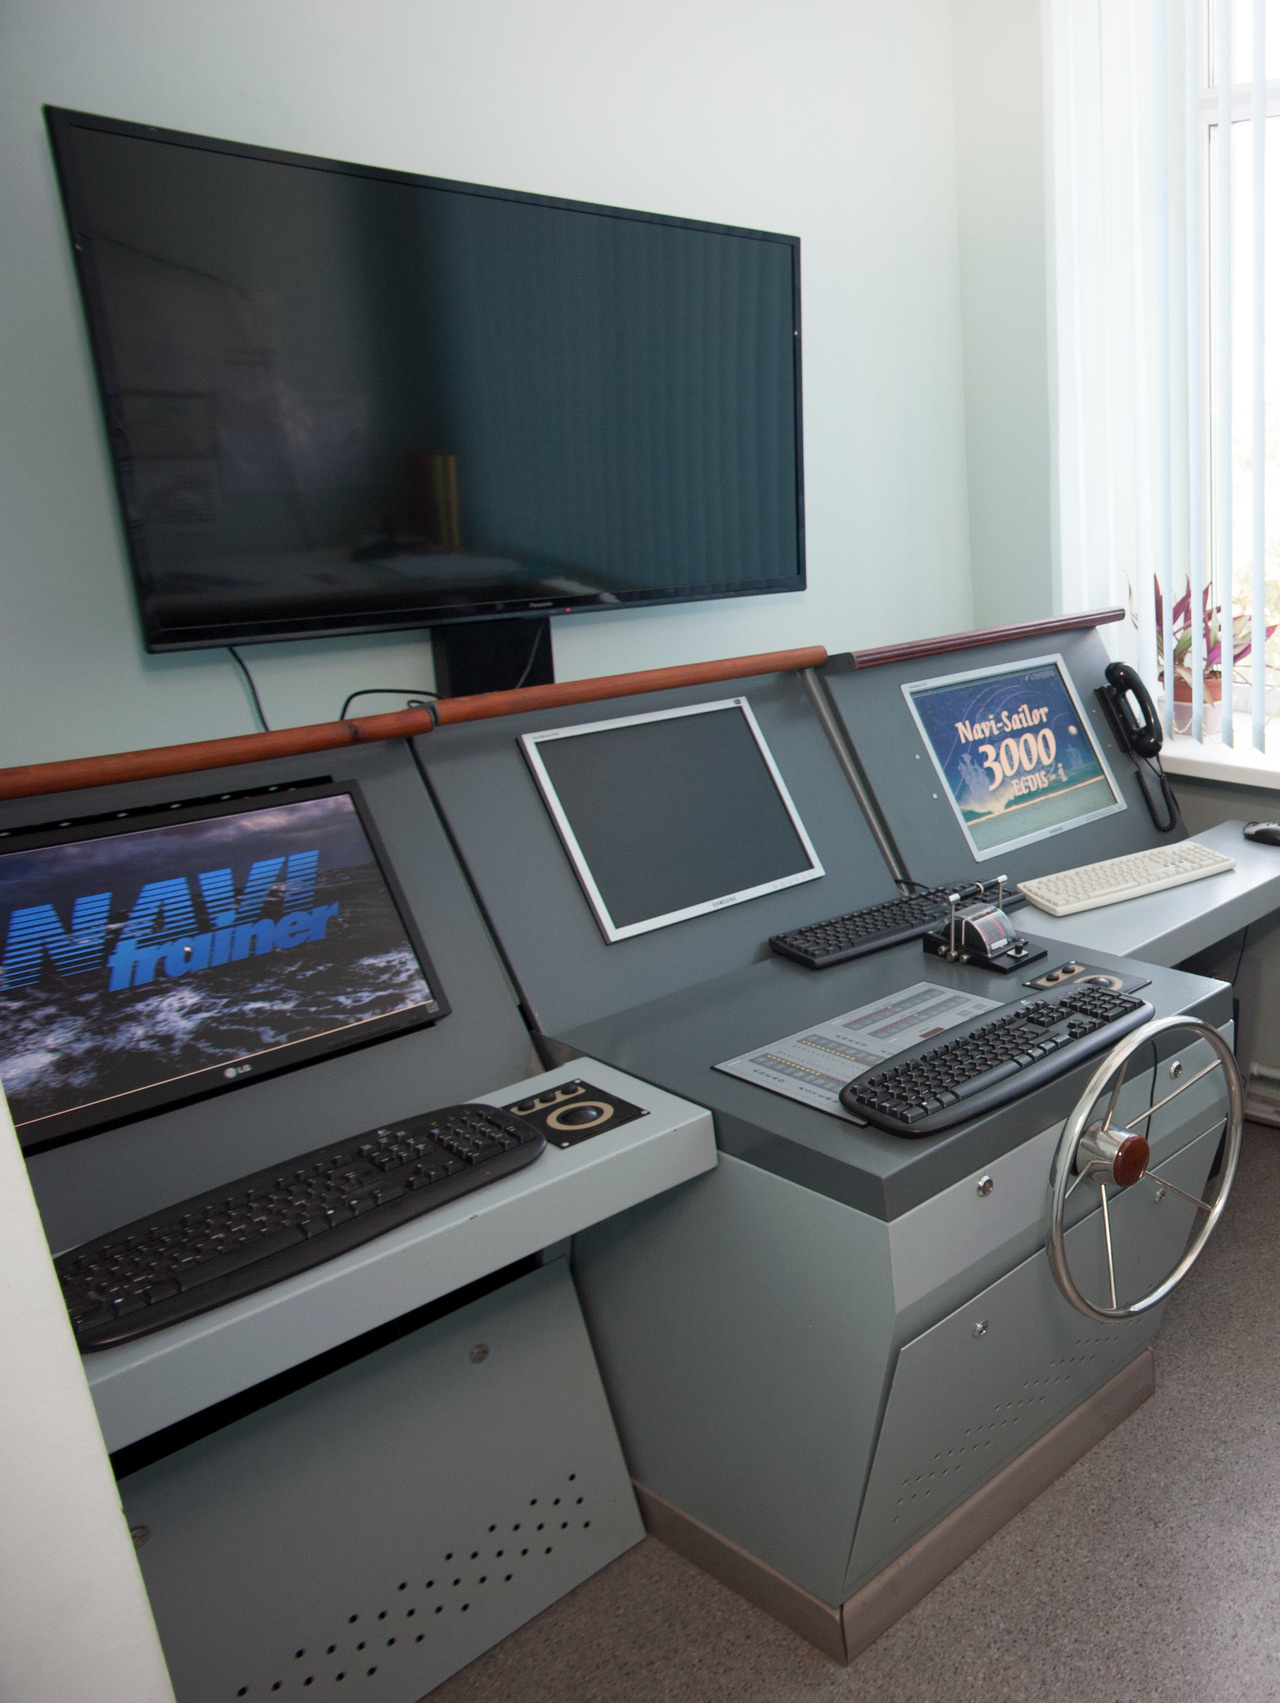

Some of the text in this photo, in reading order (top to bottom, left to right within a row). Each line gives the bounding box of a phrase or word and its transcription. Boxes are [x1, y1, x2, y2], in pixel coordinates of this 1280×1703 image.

[954, 704, 1049, 744] Navi-Sailor
[978, 728, 1056, 791] 3000
[0, 850, 320, 991] NAVI
[107, 902, 340, 992] trainer
